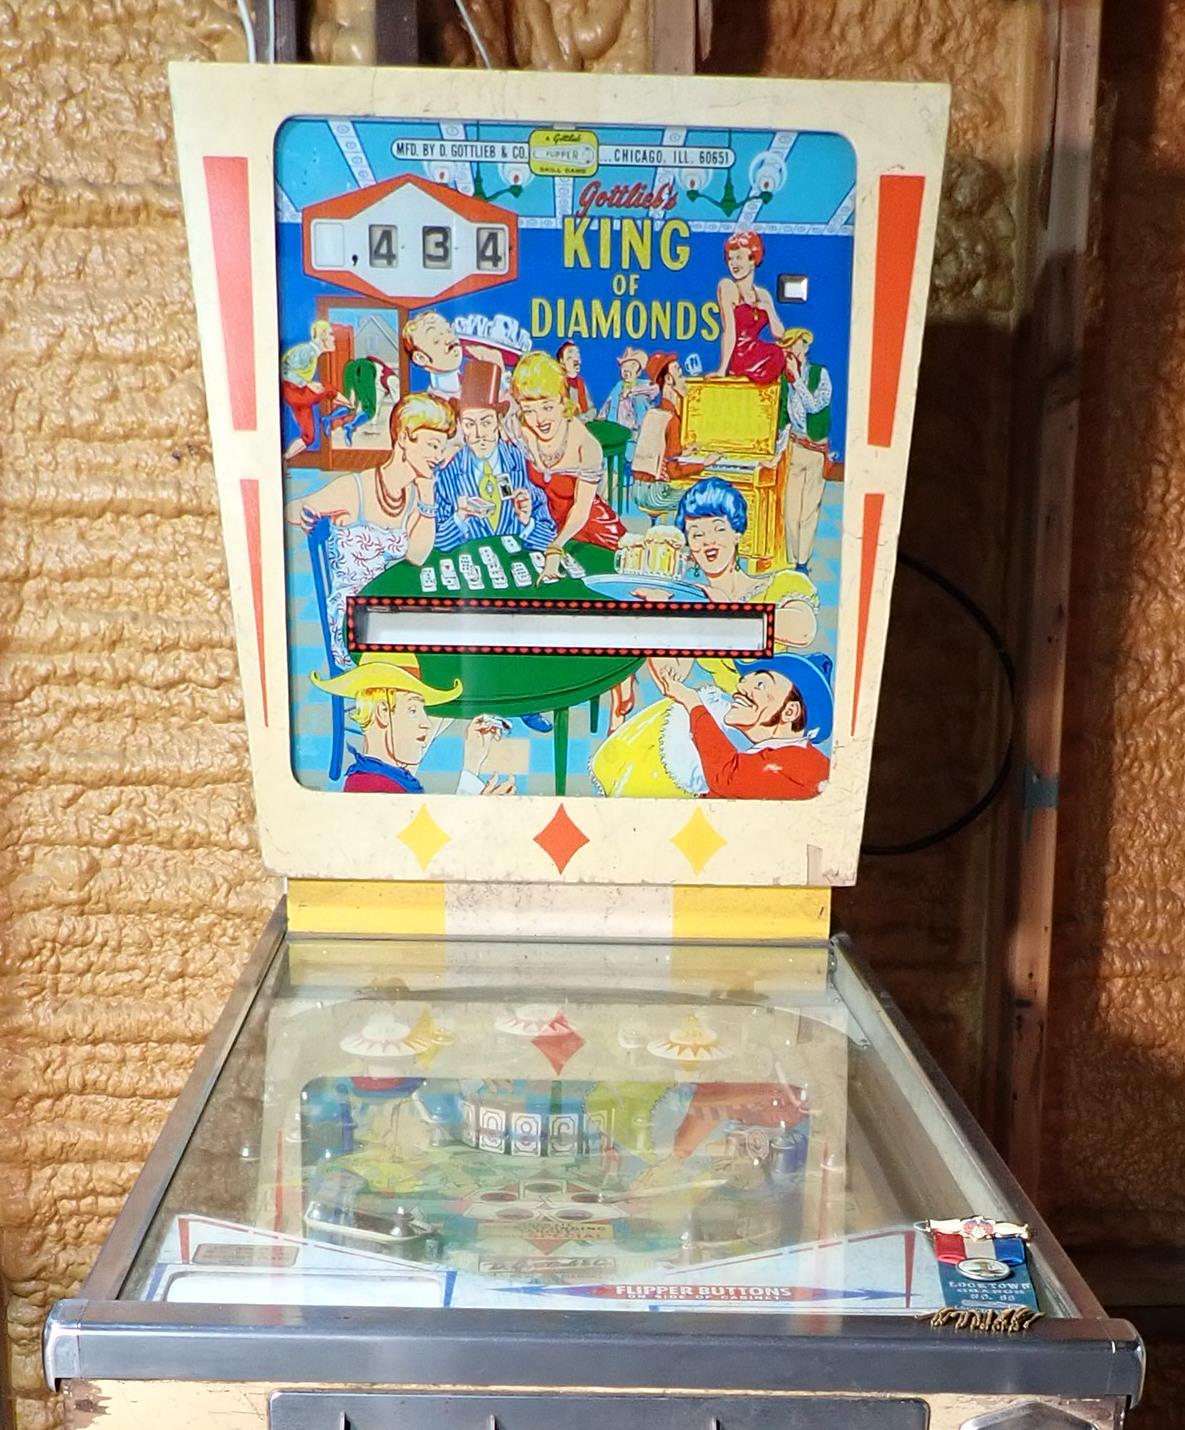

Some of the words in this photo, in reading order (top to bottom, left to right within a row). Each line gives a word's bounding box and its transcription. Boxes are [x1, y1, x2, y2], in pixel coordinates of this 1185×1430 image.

[396, 143, 418, 156] MFD.
[423, 144, 435, 156] BY
[439, 145, 448, 157] D.
[451, 145, 496, 158] GOTTLIEB
[501, 147, 508, 158] &
[512, 147, 528, 159] CO.
[699, 151, 729, 165] 60651
[576, 180, 678, 218] Gottlieb's
[563, 217, 690, 271] KING
[612, 274, 640, 296] OF
[531, 298, 720, 342] DIAMONDS
[616, 1286, 692, 1295] FLIPPER
[699, 1286, 791, 1296] BUTTONS
